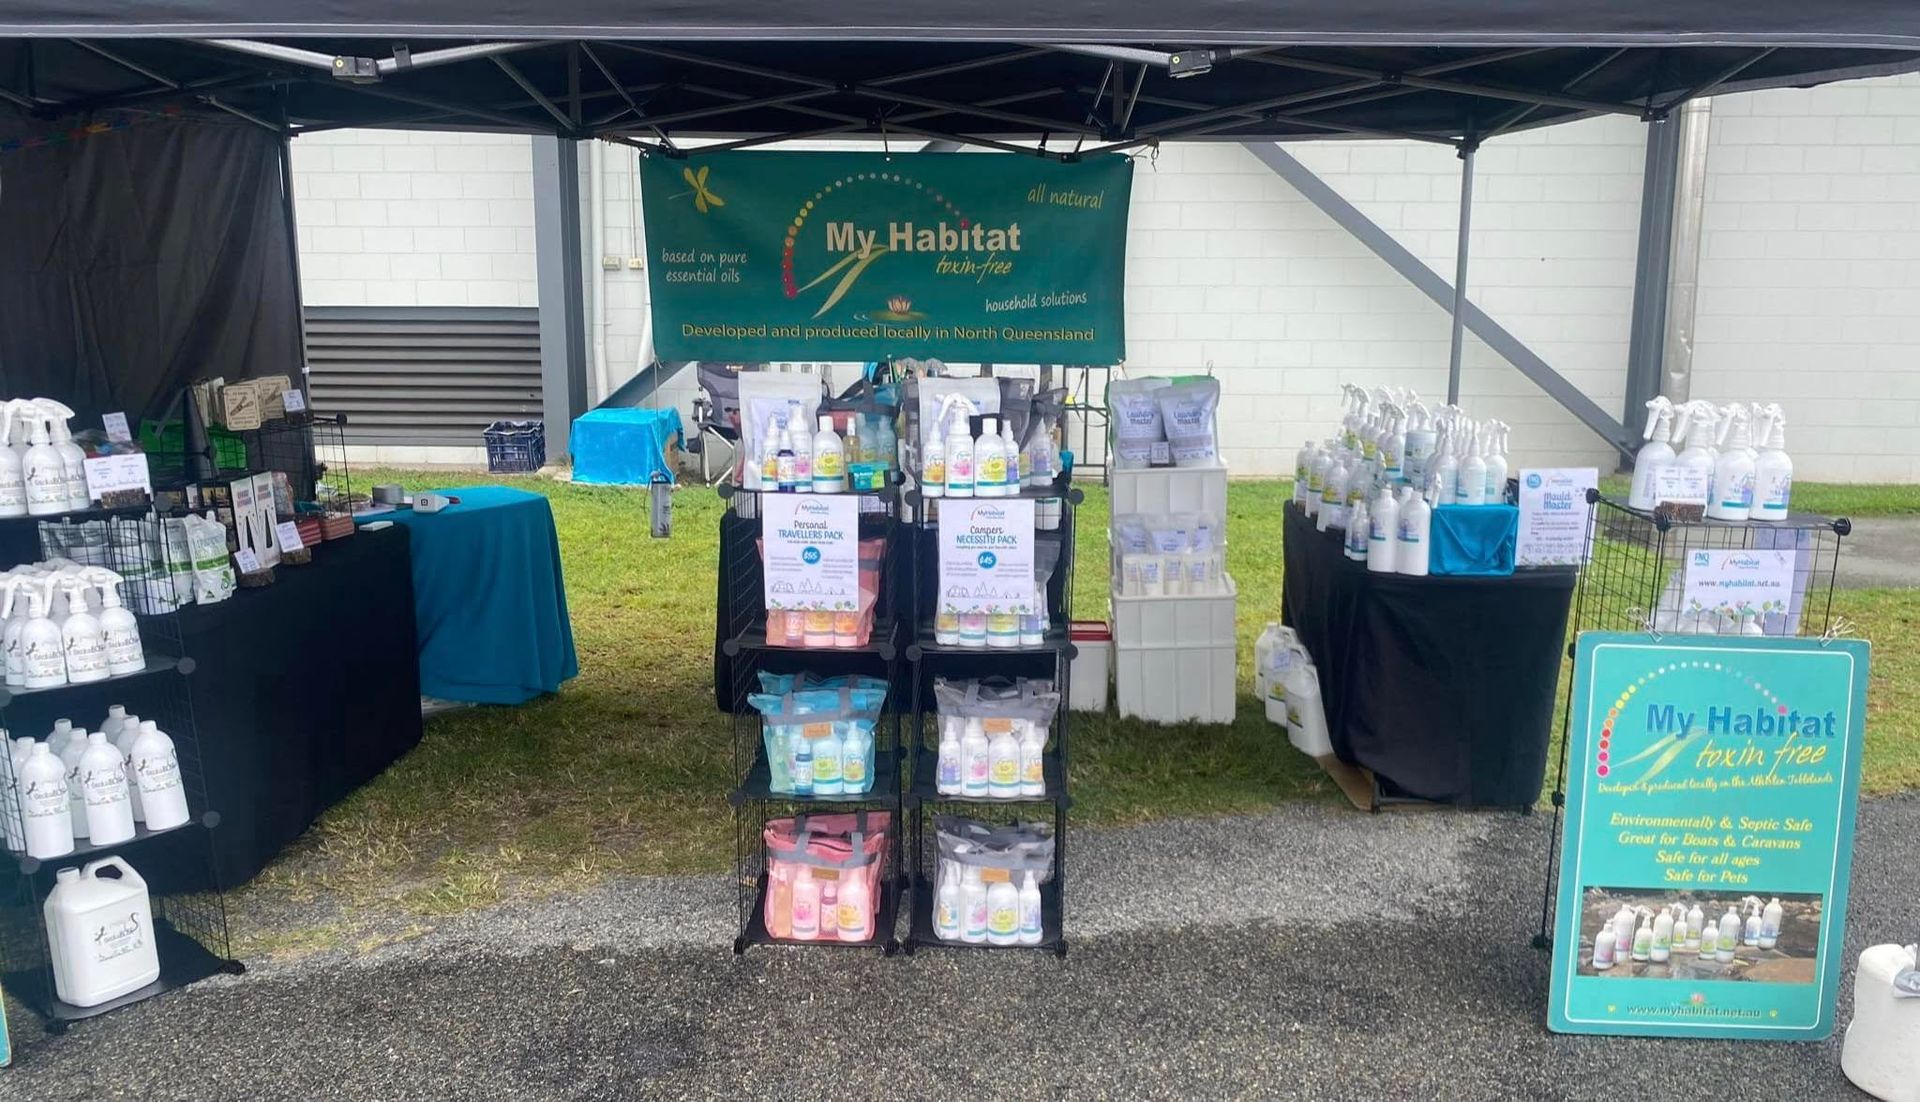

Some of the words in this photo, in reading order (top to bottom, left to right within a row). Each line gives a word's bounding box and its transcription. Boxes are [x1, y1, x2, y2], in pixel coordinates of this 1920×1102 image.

[1027, 183, 1046, 203] all
[1050, 190, 1104, 210] natural
[826, 222, 876, 260] My
[889, 218, 1021, 253] Habitat
[662, 248, 695, 263] based
[700, 252, 715, 263] on
[720, 252, 747, 268] pure
[665, 267, 716, 283] essential
[721, 267, 740, 283] oils
[936, 252, 1012, 284] toxin-free
[985, 293, 1037, 312] household
[1041, 290, 1088, 307] solutions
[682, 323, 767, 341] Developed
[771, 324, 800, 338] and
[805, 325, 879, 341] produced
[883, 325, 931, 341] locally
[936, 326, 949, 339] in
[954, 326, 998, 340] North
[1002, 327, 1095, 341] Queensland
[794, 520, 828, 529] Personal
[970, 525, 1004, 537] Campers
[778, 529, 823, 539] TRAVELLERS
[824, 531, 844, 540] PACK
[956, 535, 995, 544] NECESSITY
[997, 535, 1017, 545] PACK
[1647, 704, 1695, 740] My
[1708, 704, 1836, 738] Habitat
[1696, 739, 1764, 767] toxin
[1770, 731, 1827, 777] free
[1689, 777, 1718, 792] locally
[1731, 774, 1746, 788] the
[1610, 812, 1715, 830] Environmentally
[1719, 817, 1733, 829] &
[1738, 816, 1780, 832] Septic
[1783, 818, 1813, 832] Safe
[1618, 831, 1657, 845] Great
[1659, 832, 1678, 845] for
[1682, 833, 1719, 847] Boats
[1723, 835, 1737, 848] &
[1742, 836, 1801, 850] Caravans
[1656, 850, 1685, 864] Safe
[1688, 851, 1708, 864] for
[1711, 853, 1729, 866] all
[1731, 856, 1761, 868] ages
[1664, 868, 1693, 882] Safe
[1697, 870, 1716, 883] for
[1720, 872, 1748, 884] Pets
[1627, 1004, 1761, 1018] www.myhabitat.net.au
